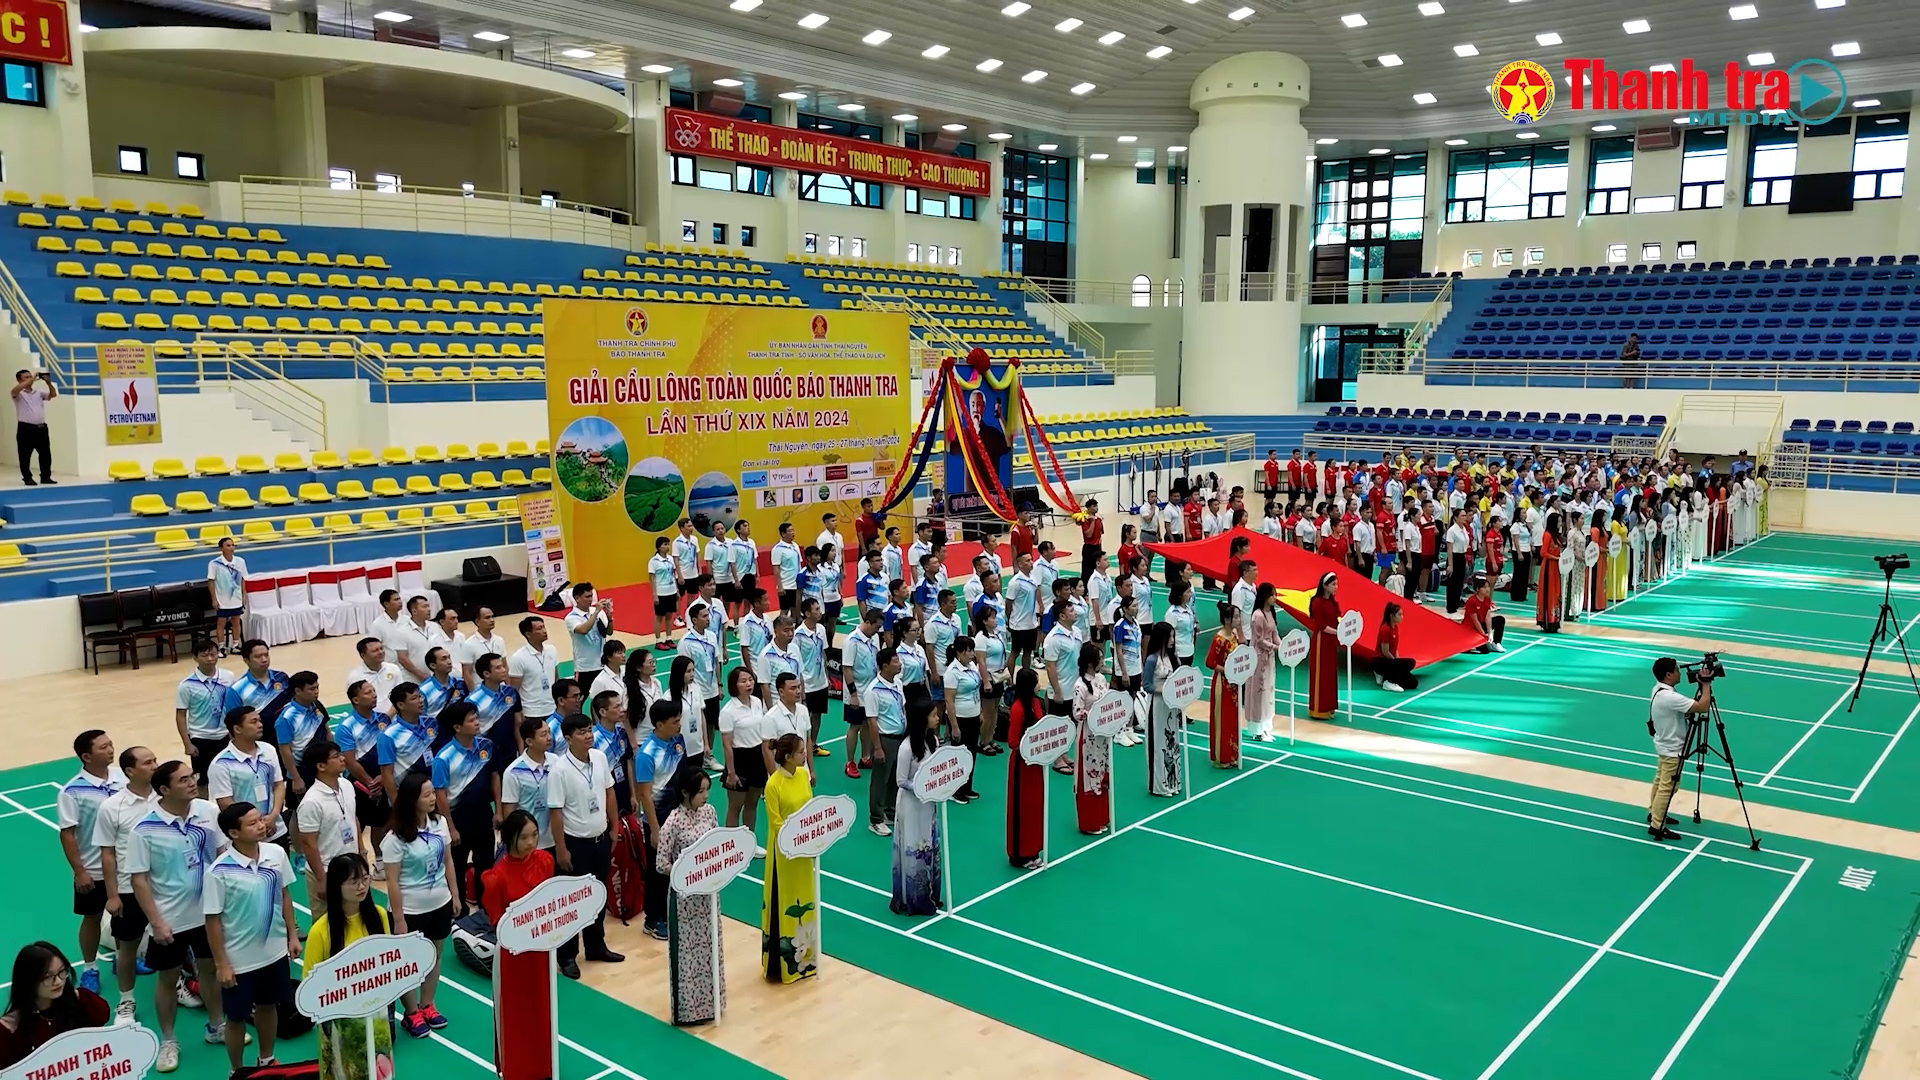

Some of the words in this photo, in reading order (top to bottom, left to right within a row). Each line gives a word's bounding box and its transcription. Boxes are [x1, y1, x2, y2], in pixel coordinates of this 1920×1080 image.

[709, 122, 735, 151] THỂ
[737, 132, 768, 157] THAO
[781, 137, 814, 163] ĐOÀN
[817, 141, 838, 166] KẾT
[848, 150, 884, 174] TRUNG
[885, 156, 913, 181] THỰC
[921, 162, 940, 184] CAO
[942, 166, 980, 188] THƯỢNG
[569, 369, 608, 404] GIẢI
[615, 369, 651, 403] CẦU
[656, 373, 701, 402] LÔNG
[706, 372, 747, 400] TOÀN
[753, 366, 792, 402] QUỐC
[797, 371, 825, 398] BÁO
[829, 375, 872, 398] THANH
[876, 375, 898, 396] TRA
[109, 412, 157, 424] PETROVIETNAM
[646, 409, 690, 437] LẦN
[694, 410, 732, 434] THỨ
[737, 412, 766, 433] XIX
[772, 408, 809, 431] NĂM
[814, 409, 850, 428] 2024
[840, 439, 848, 447] 27
[167, 611, 190, 621] YONEX
[1100, 702, 1114, 713] THANH
[1114, 699, 1123, 709] TRA
[930, 761, 948, 776] THANH
[948, 756, 959, 769] TRA
[793, 831, 811, 848] TỈNH
[811, 824, 826, 843] BẮC
[826, 817, 844, 835] NINH
[799, 813, 823, 829] THANH
[824, 805, 838, 819] TRA
[693, 846, 721, 866] THANH
[721, 839, 736, 853] TRA
[685, 870, 703, 887] TỈNH
[704, 862, 723, 880] VĨNH
[724, 851, 745, 870] PHÚC
[512, 912, 534, 930] THANH
[534, 906, 547, 920] TRA
[547, 900, 557, 916] BỘ
[557, 895, 568, 910] TÀI
[568, 885, 593, 906] NGUYÊN
[530, 926, 540, 940] VÀ
[541, 920, 554, 937] MÔI
[554, 909, 579, 931] TRƯỜNG
[334, 956, 376, 982] THANH
[379, 948, 402, 968] TRA
[318, 986, 348, 1008] TỈNH
[350, 973, 392, 996] THANH
[395, 961, 419, 981] HÓA
[25, 1055, 80, 1080] THANH
[83, 1043, 113, 1065] TRA
